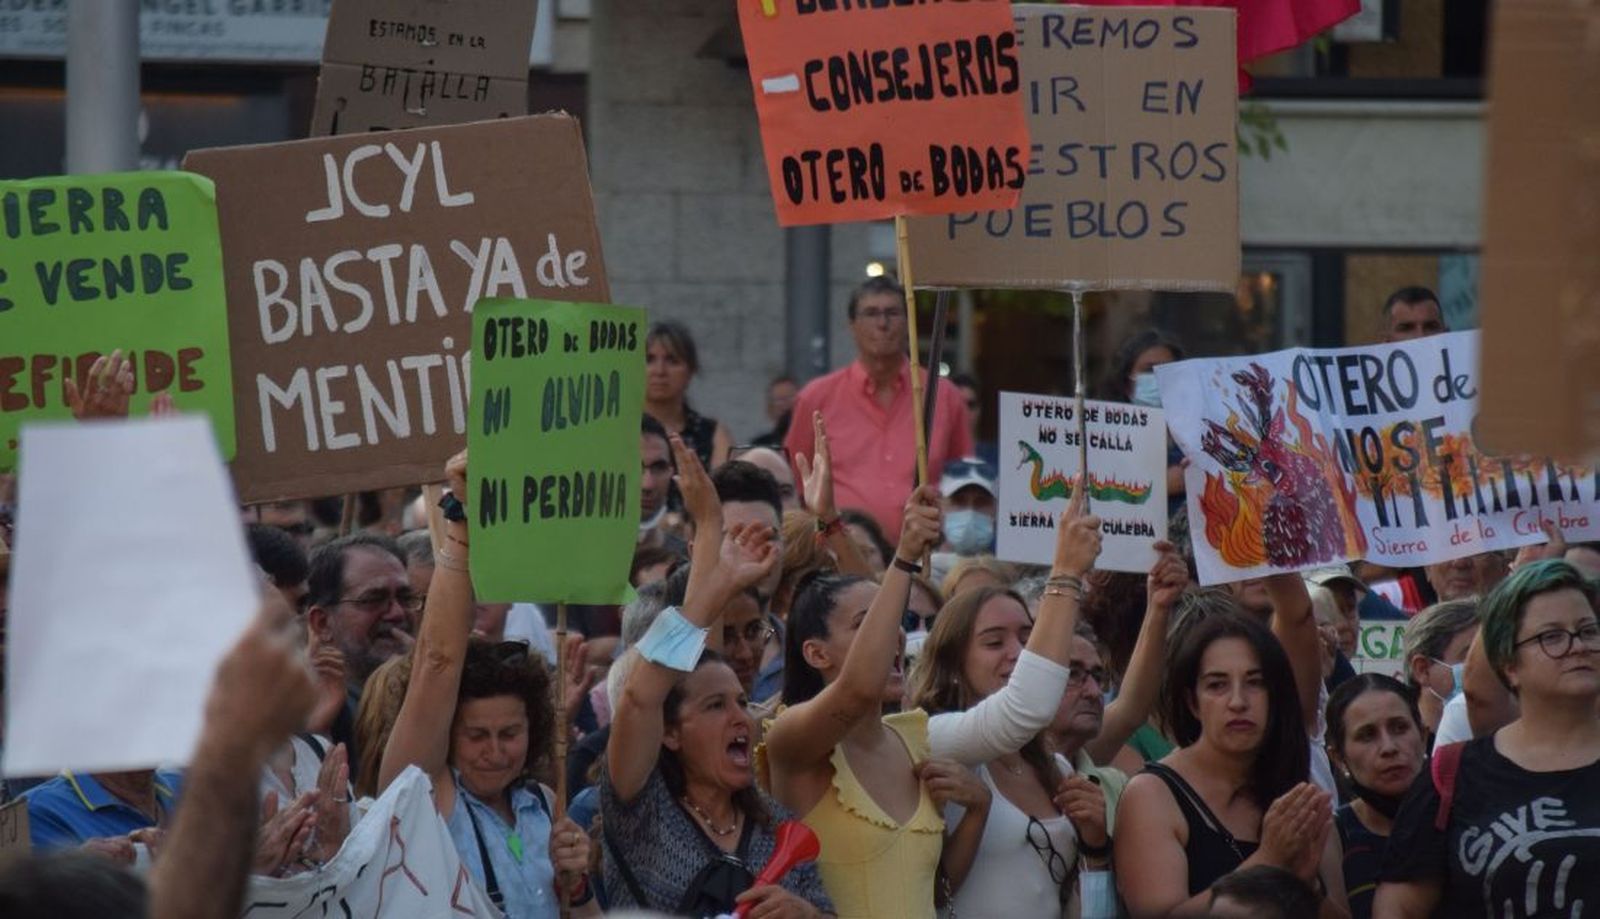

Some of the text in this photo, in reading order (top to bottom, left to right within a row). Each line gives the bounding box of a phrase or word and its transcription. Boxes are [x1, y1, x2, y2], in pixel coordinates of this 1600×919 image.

[369, 19, 437, 44] ESTAMOS
[448, 33, 464, 46] EN
[359, 65, 490, 106] BATALLA
[804, 31, 1020, 112] CONSEJEROS
[1030, 76, 1204, 115] IR EN
[305, 140, 475, 223] JCYL
[782, 142, 1025, 206] OTERO DE BODAS
[3, 187, 168, 239] IERRA
[948, 200, 1188, 240] PUEBLOS
[35, 253, 193, 305] VENDE
[253, 233, 589, 344] BASTA YA de
[484, 316, 549, 361] OTERO
[589, 319, 637, 353] BODAS
[483, 369, 620, 437] NI OLVIDA
[1292, 349, 1478, 416] OTERO de
[1022, 402, 1073, 420] OTERO
[1105, 408, 1149, 426] BODAS
[1038, 428, 1057, 444] NO
[1090, 433, 1133, 452] CALLA
[479, 470, 627, 529] NI PERDONA
[1009, 512, 1156, 538] SIERRA CULEBRA
[1372, 526, 1428, 556] Sierra
[1450, 523, 1472, 546] de
[1477, 519, 1496, 539] la
